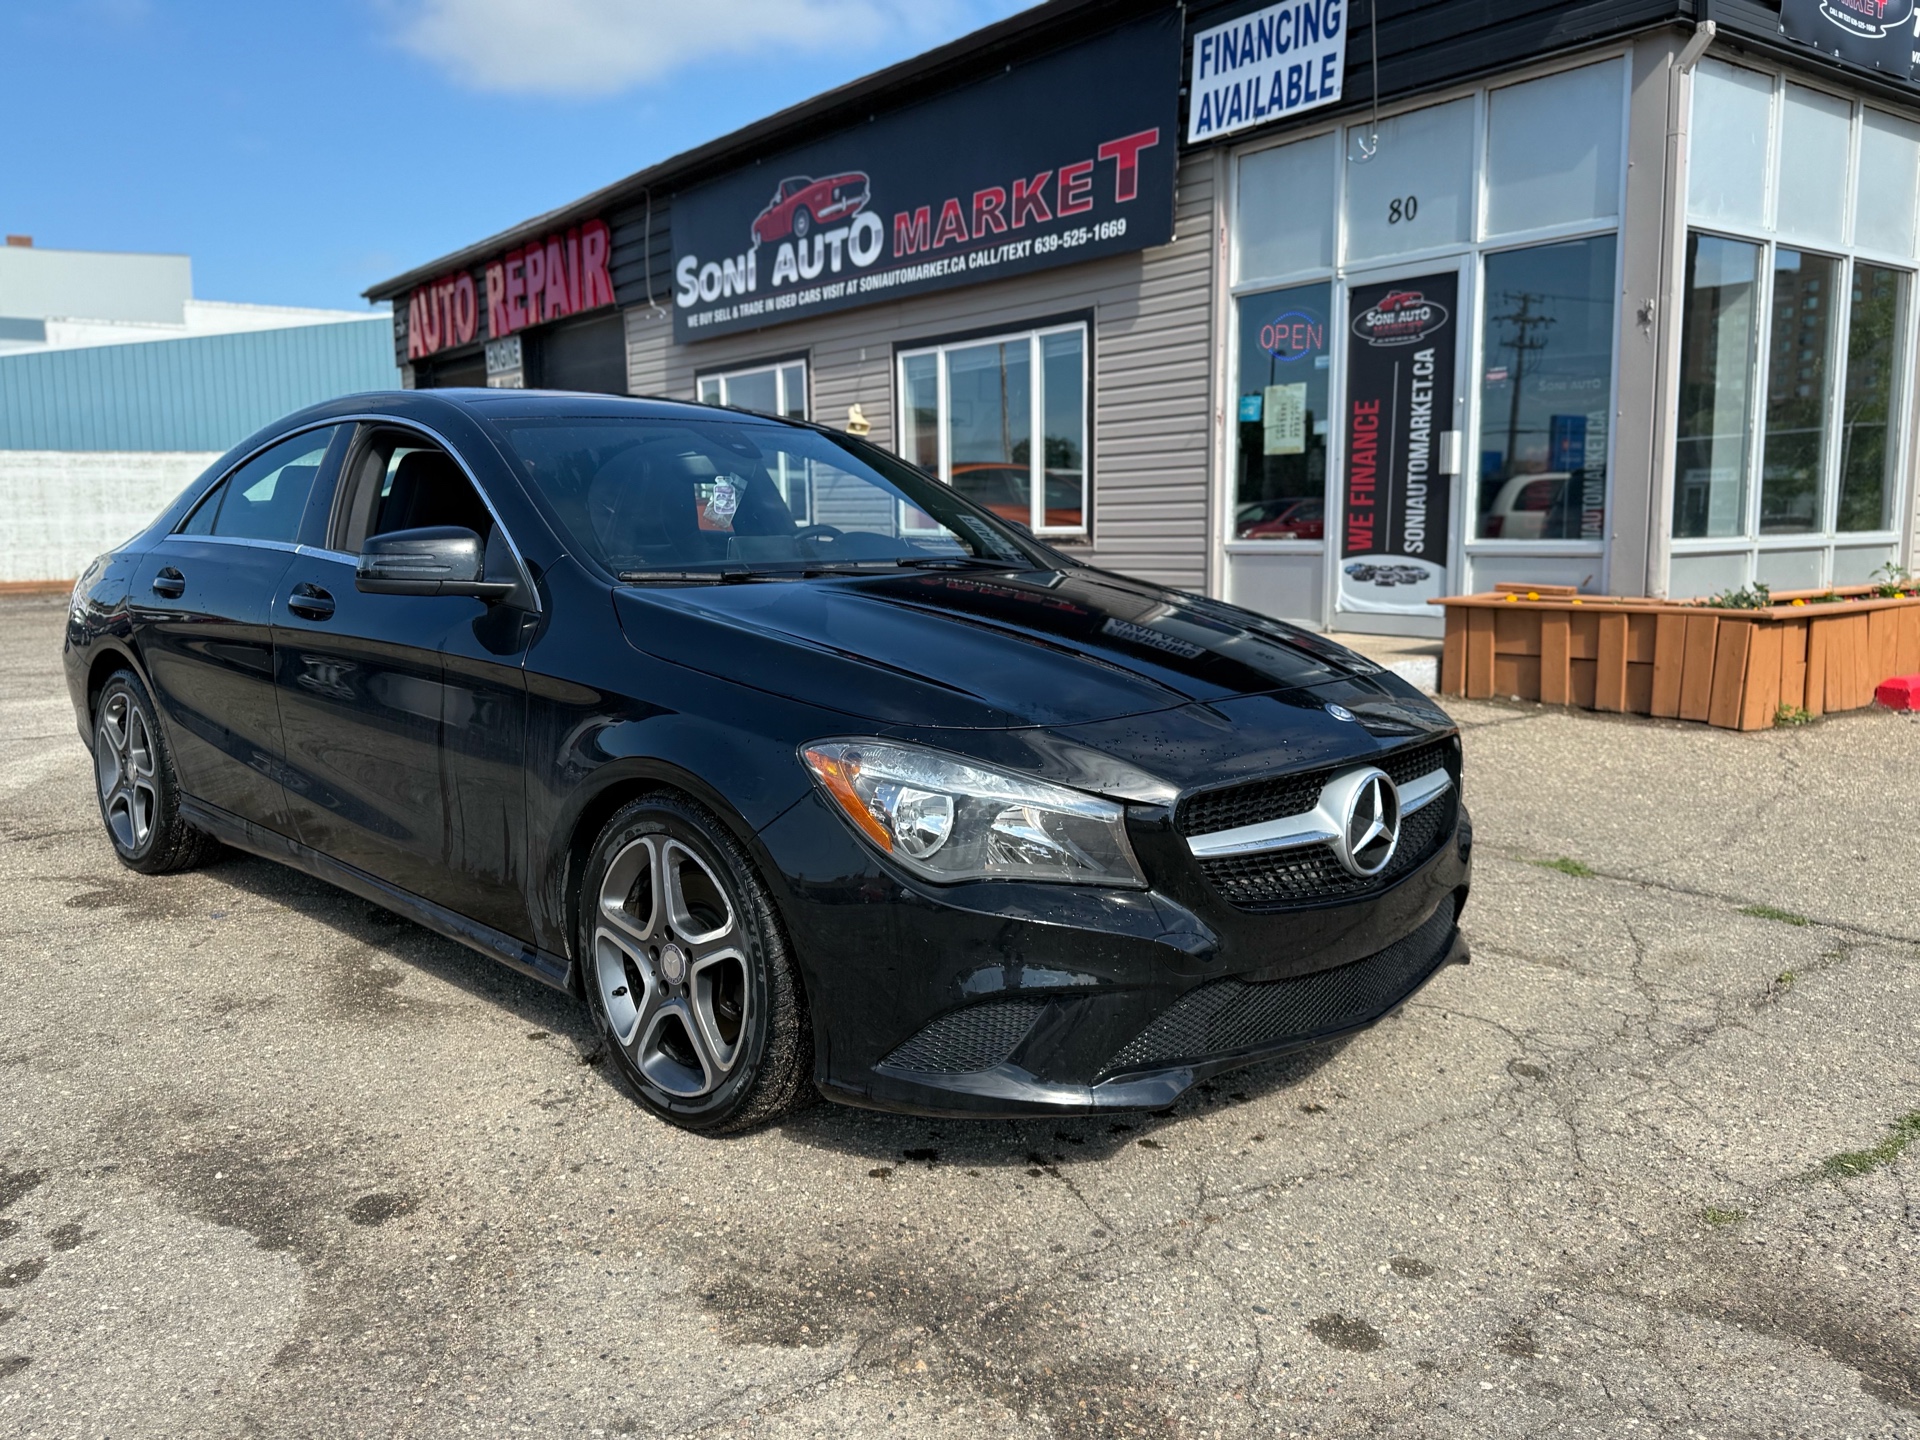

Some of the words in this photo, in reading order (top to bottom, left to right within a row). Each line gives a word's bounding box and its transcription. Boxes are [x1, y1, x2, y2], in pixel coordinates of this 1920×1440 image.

[1200, 0, 1341, 80] FINANCING
[1196, 52, 1337, 135] AVAILABLE
[893, 127, 1159, 257] MARKET
[1388, 195, 1417, 225] 80
[408, 271, 478, 360] AUTO
[485, 218, 616, 338] REPAIR
[676, 248, 756, 308] SONI
[772, 211, 884, 286] AUTO
[687, 314, 698, 328] WE
[698, 310, 713, 326] BUY
[714, 306, 731, 323] SELL
[732, 305, 739, 319] &
[740, 300, 764, 318] TRADE
[765, 299, 775, 313] IN
[775, 295, 797, 310] USED
[798, 289, 821, 306] CARS
[822, 282, 846, 300] VISIT
[846, 278, 858, 295] AT
[860, 255, 966, 292] SONIAUTOMARKET.CA
[968, 239, 1032, 270] CALL/TEXT
[1034, 217, 1127, 254] 639-525-1669
[1260, 324, 1322, 350] OPEN
[1366, 311, 1395, 326] SONI
[1398, 306, 1431, 323] AUTO
[1349, 398, 1380, 506] FINANCE
[1403, 347, 1436, 554] SONIAUTOMARKET.CA
[1581, 410, 1606, 540] IAUTOMARKET.CA
[1347, 513, 1374, 551] WE
